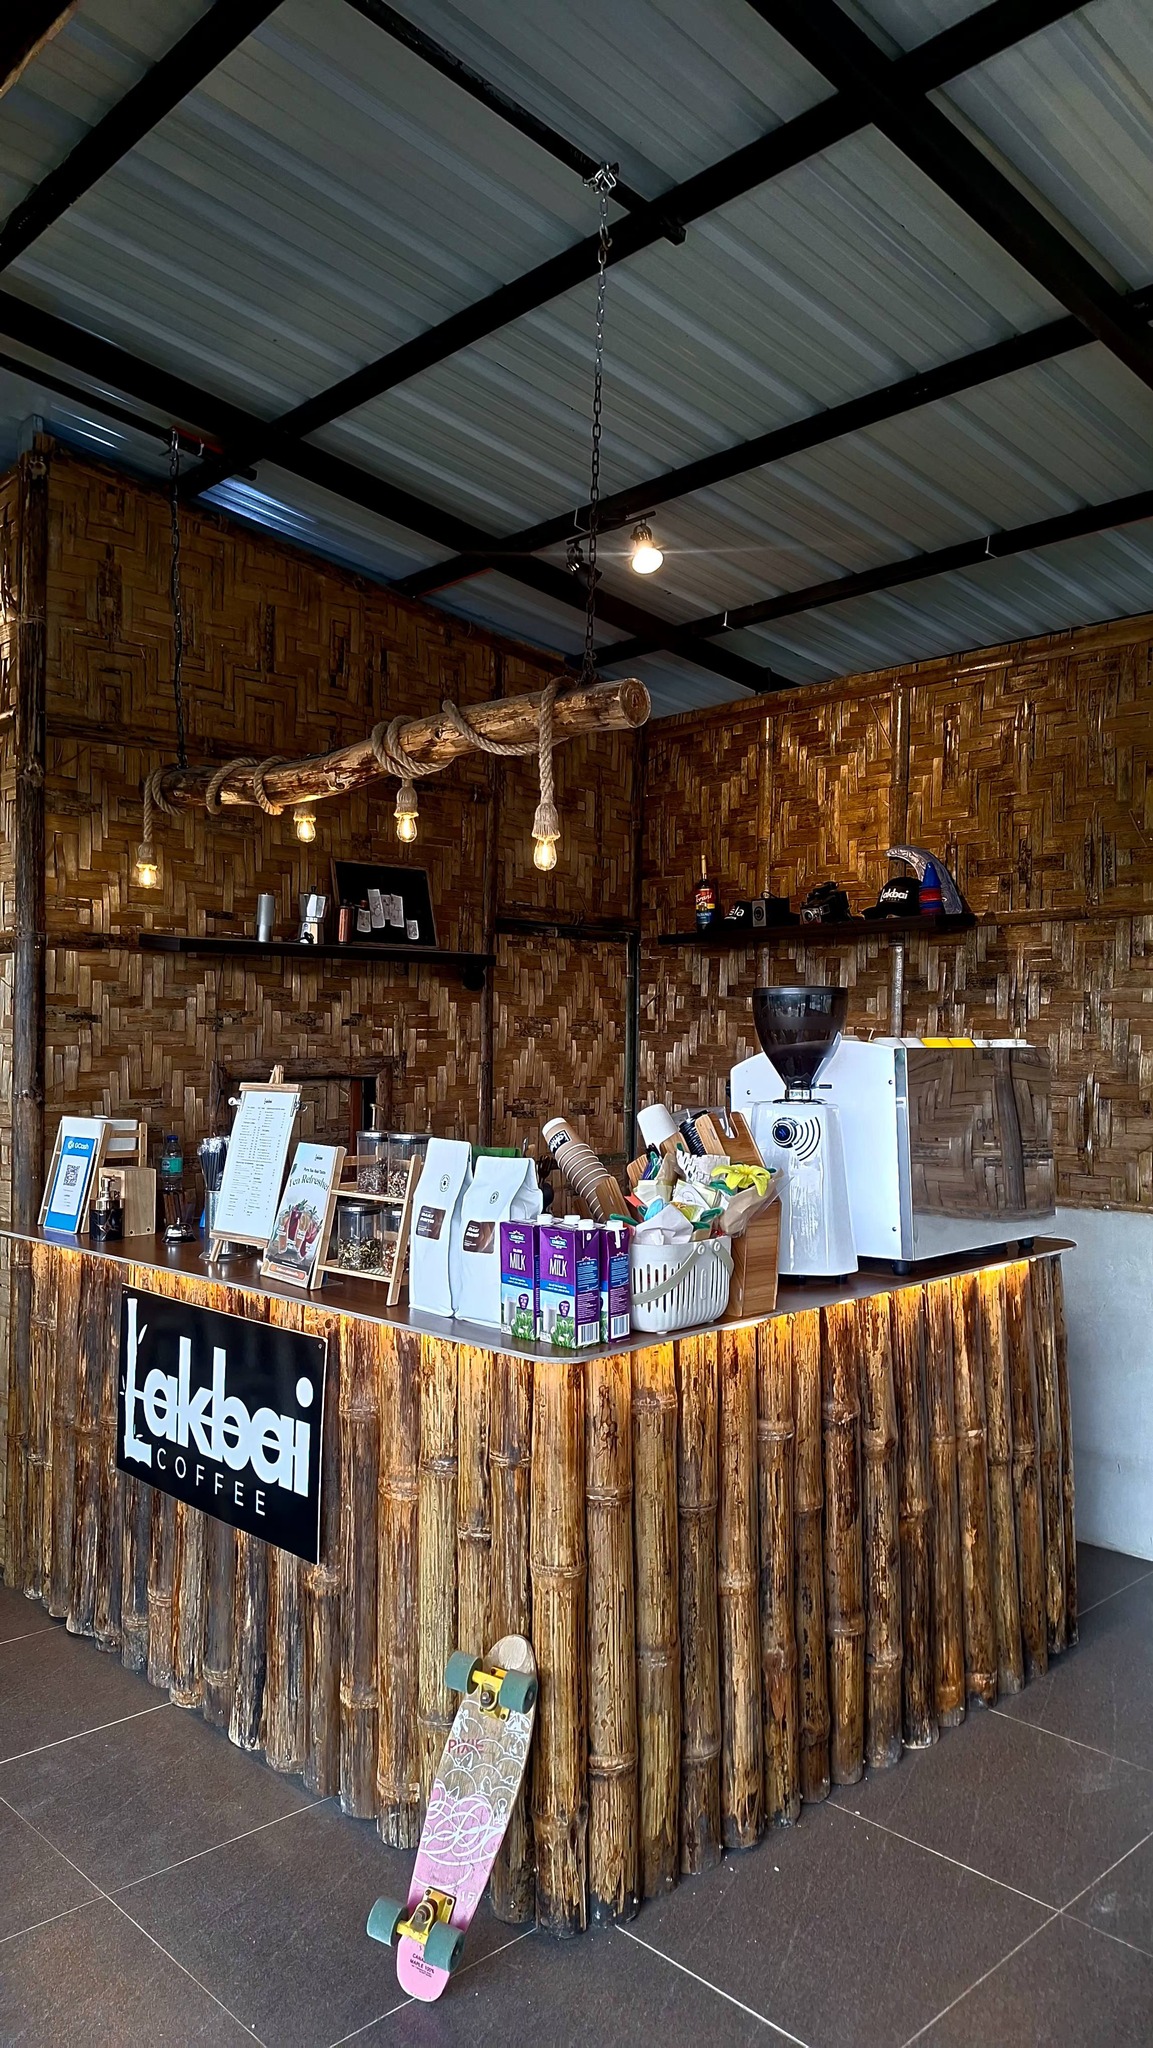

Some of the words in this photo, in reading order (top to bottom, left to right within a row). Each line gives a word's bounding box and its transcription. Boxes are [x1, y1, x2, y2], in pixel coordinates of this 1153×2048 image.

[509, 1252, 526, 1272] MILK
[549, 1258, 568, 1278] MILK
[123, 1297, 314, 1498] Lakbai
[156, 1447, 266, 1516] COFFEE
